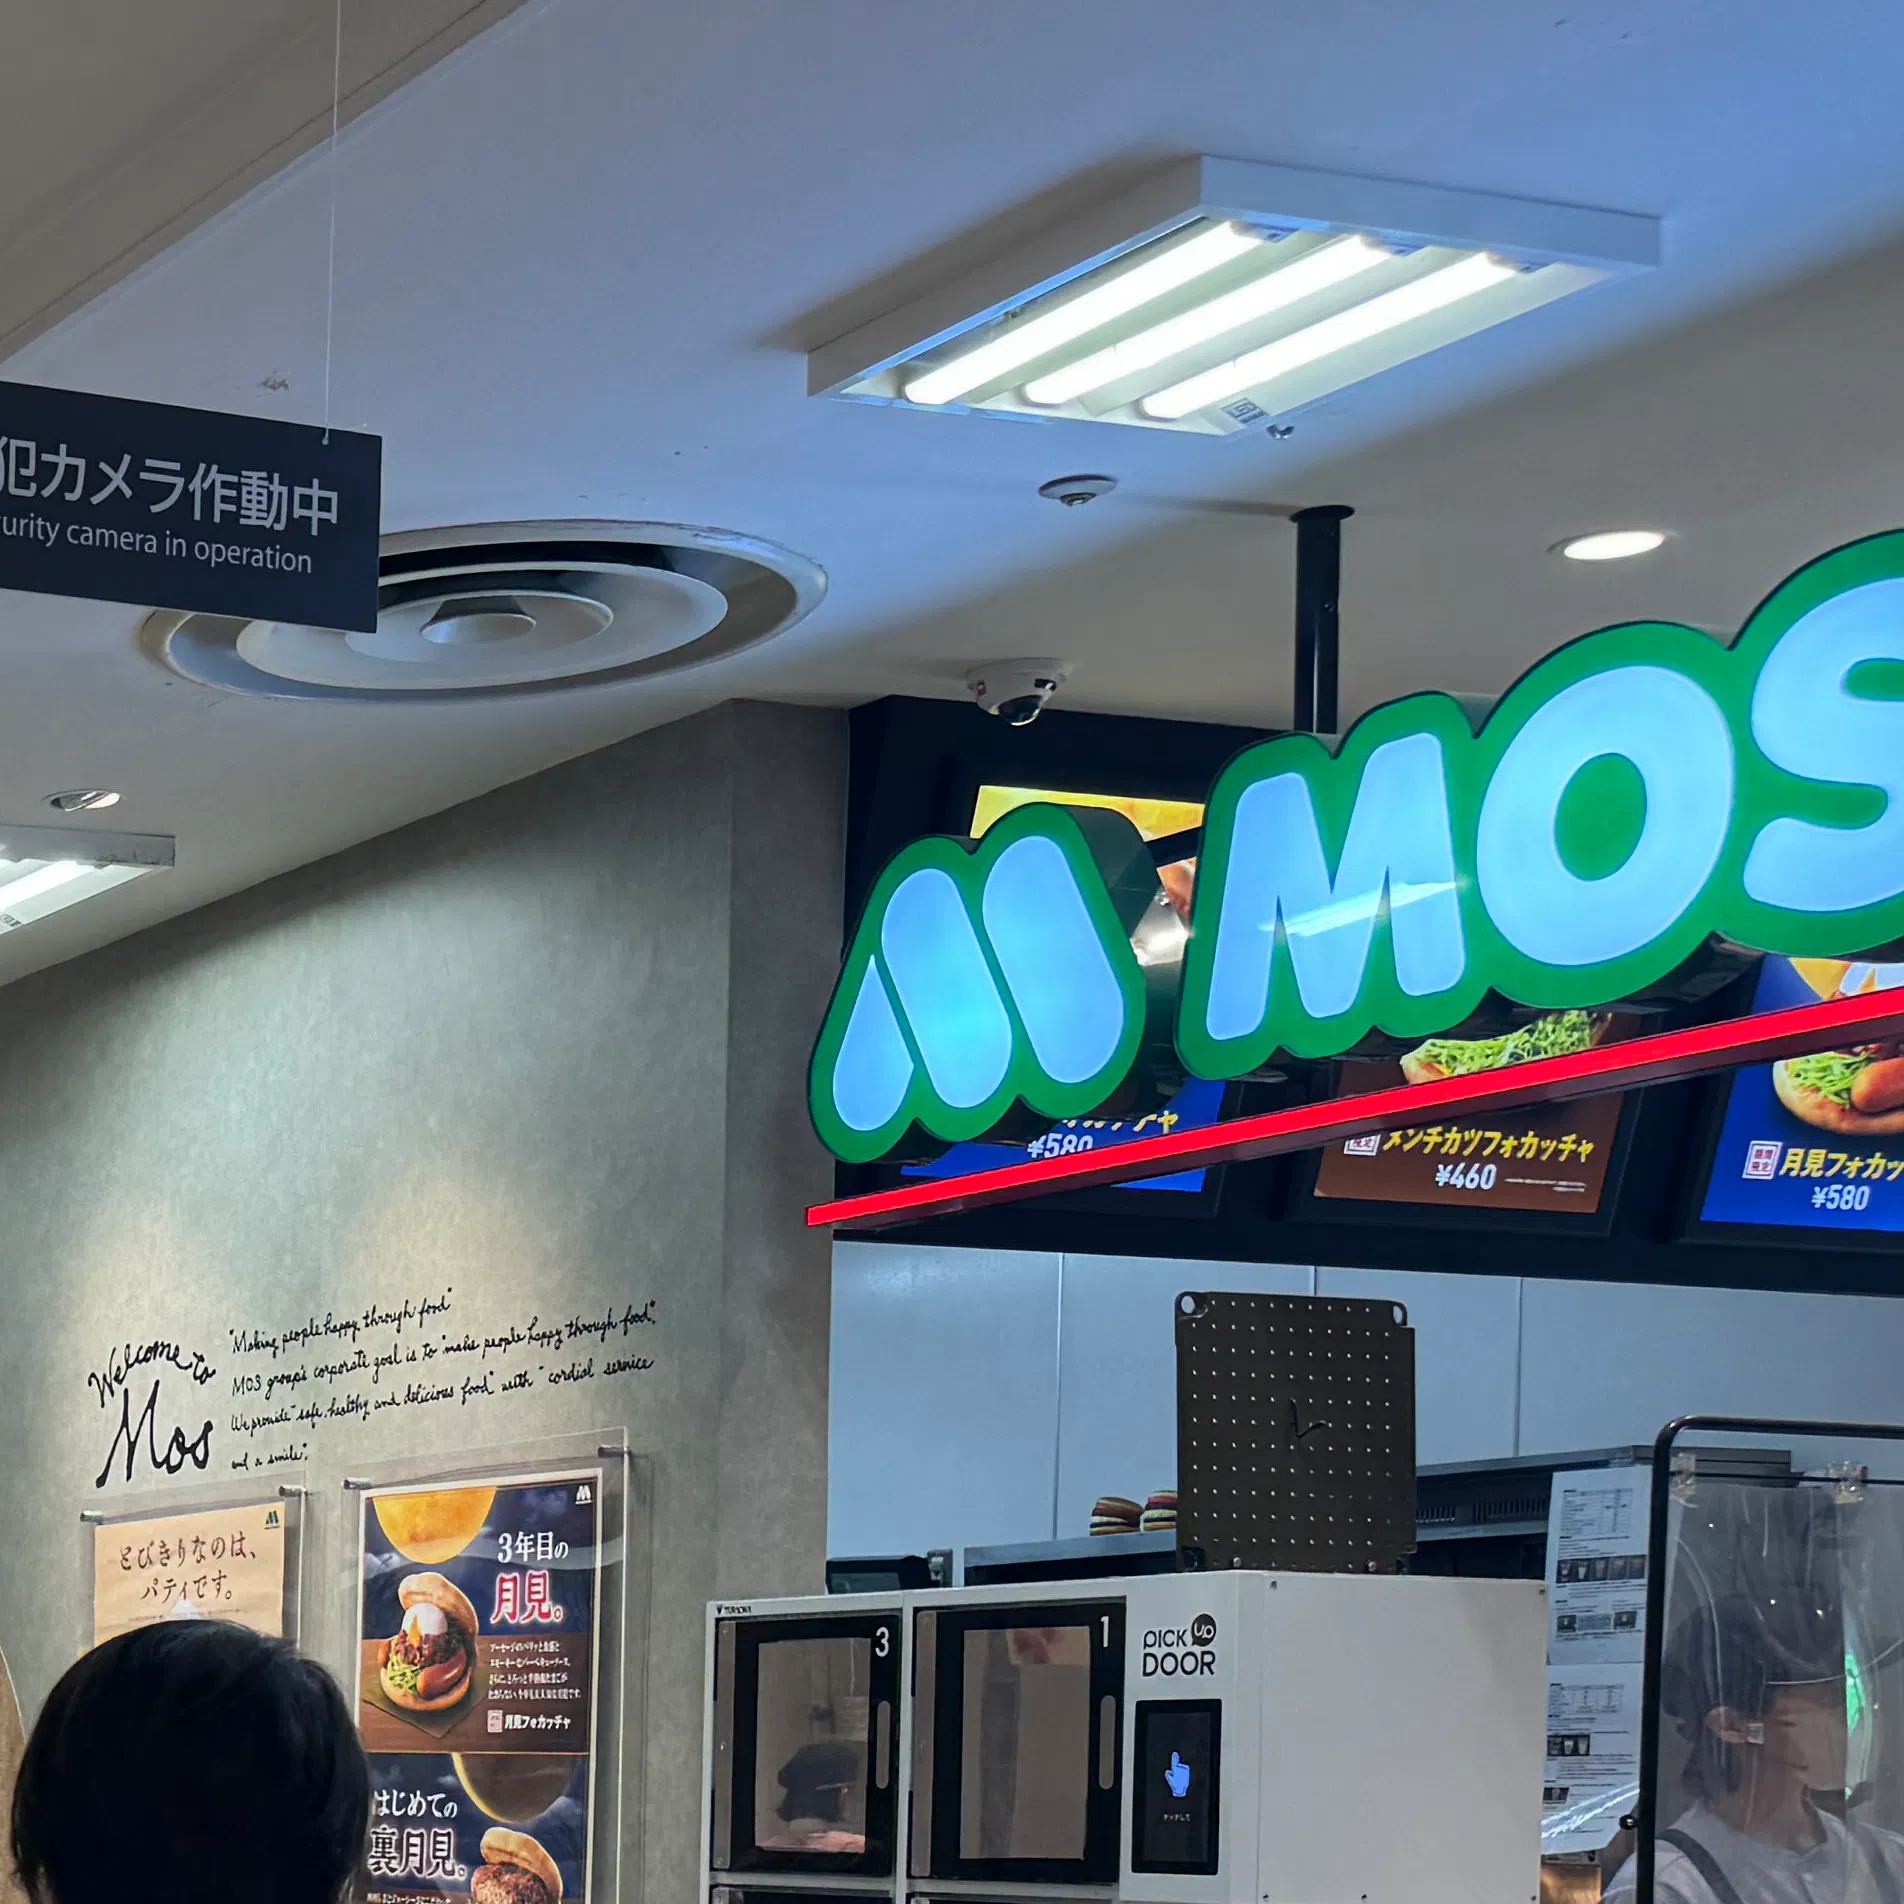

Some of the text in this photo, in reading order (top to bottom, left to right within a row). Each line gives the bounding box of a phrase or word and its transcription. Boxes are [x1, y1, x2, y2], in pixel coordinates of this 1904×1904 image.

[66, 521, 157, 555] camera
[165, 531, 187, 557] in
[194, 539, 312, 575] operation
[1207, 575, 1904, 1042] MOS
[1383, 1126, 1594, 1163] メンチカツフォカッチャ
[1434, 1162, 1497, 1190] ¥460
[1811, 1184, 1871, 1211] ¥580
[282, 1318, 322, 1349] people
[323, 1313, 360, 1342] happy
[363, 1300, 415, 1334] through
[232, 1376, 261, 1397] MOS
[313, 1350, 370, 1383] corporate
[373, 1344, 402, 1383] goal
[406, 1345, 417, 1362] is
[423, 1343, 438, 1360] to
[483, 1327, 527, 1358] people
[527, 1316, 563, 1350] happy
[565, 1308, 618, 1343] through
[88, 1340, 217, 1408] Welcome to
[231, 1413, 250, 1432] We
[329, 1394, 370, 1423] healthy
[374, 1392, 401, 1411] and
[403, 1383, 455, 1405] delicious
[501, 1371, 534, 1393] with
[603, 1354, 655, 1376] service
[96, 1378, 214, 1488] Mos
[120, 1530, 256, 1571] とびきりなのは、
[497, 1531, 569, 1564] 3年目の
[140, 1569, 233, 1604] パティです。
[490, 1569, 565, 1625] 月見。
[874, 1626, 890, 1659] 3
[1100, 1615, 1110, 1649] 1
[1144, 1628, 1188, 1650] PICK
[1142, 1650, 1216, 1677] DOOR
[372, 1789, 458, 1819] はじめての
[366, 1824, 466, 1882] 裏月見。
